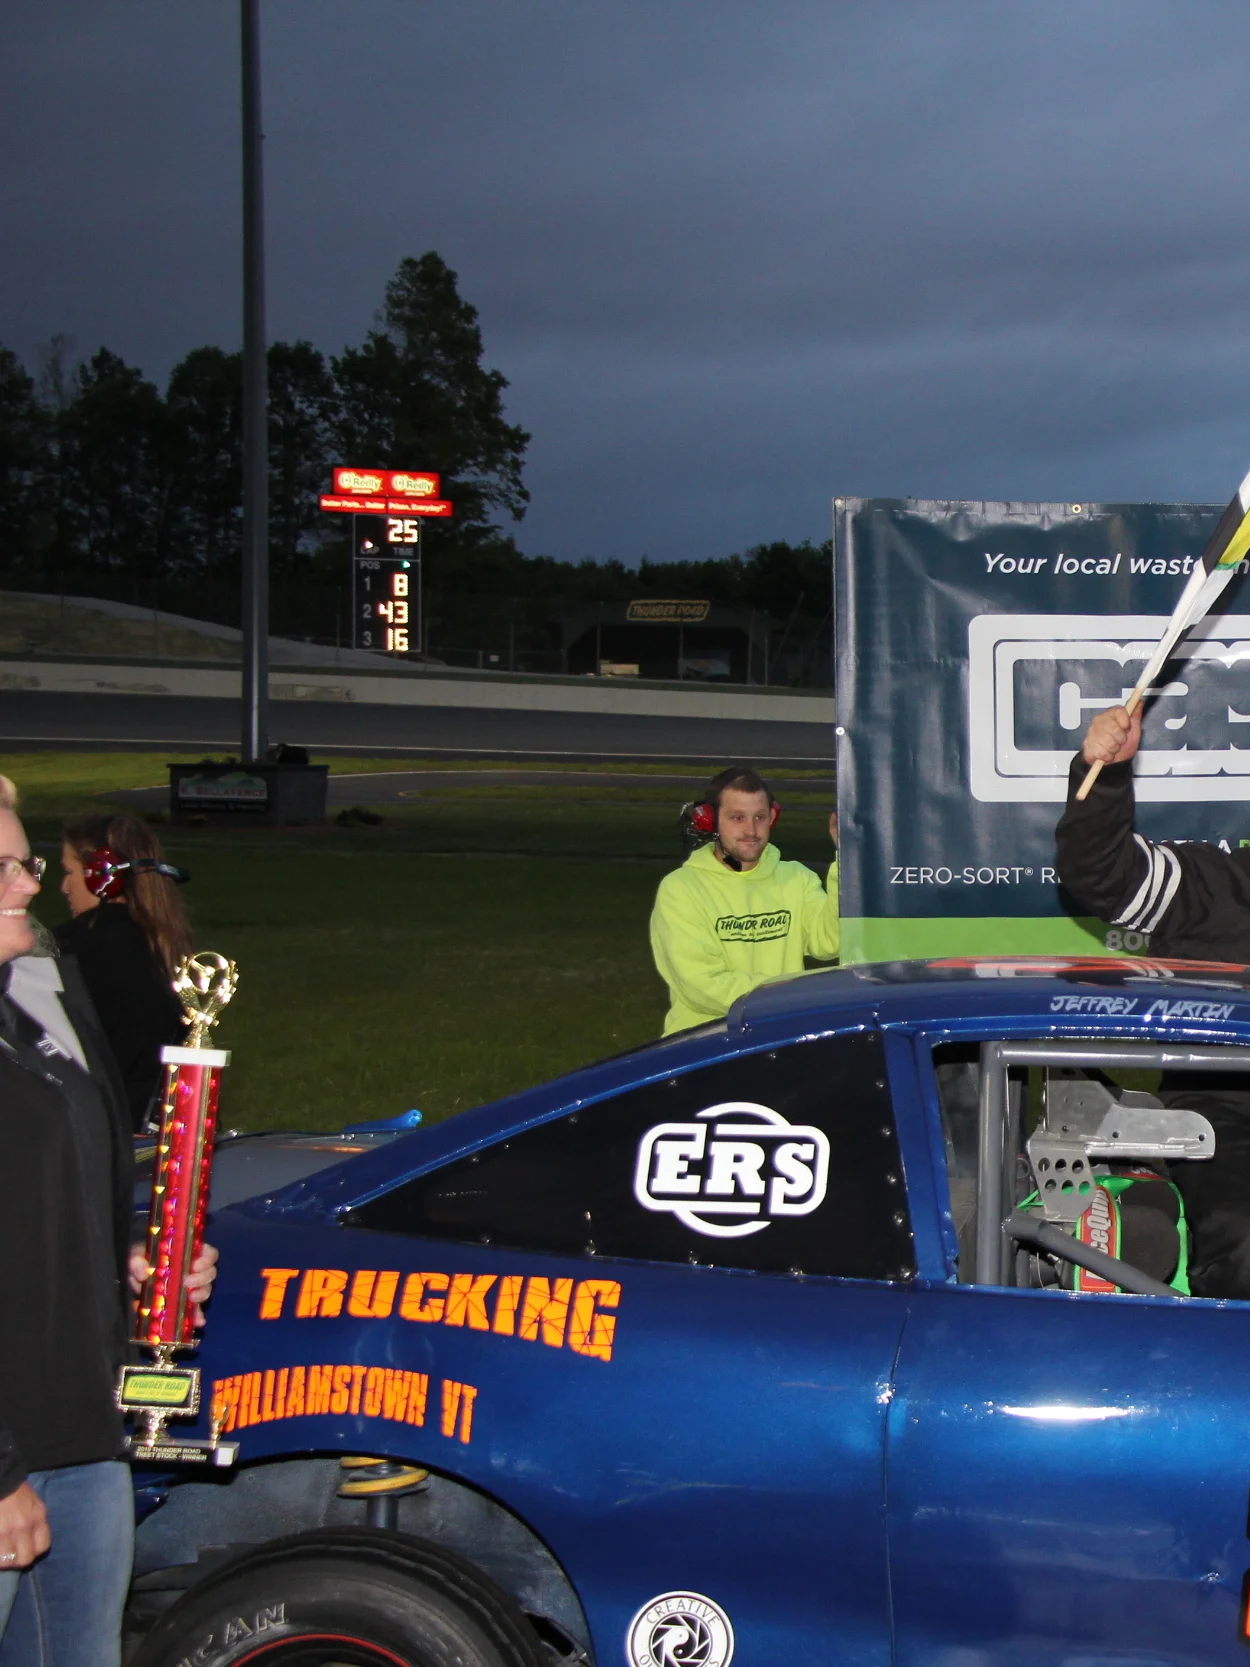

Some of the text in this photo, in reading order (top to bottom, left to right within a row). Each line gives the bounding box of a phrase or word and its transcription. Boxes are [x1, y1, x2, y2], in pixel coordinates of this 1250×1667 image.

[387, 518, 419, 543] 25
[393, 547, 414, 555] TIME
[360, 560, 381, 570] POS
[984, 552, 1047, 574] Your
[1053, 553, 1122, 575] local
[1130, 554, 1202, 575] wast
[364, 572, 409, 597] 1 8
[362, 600, 409, 624] 2 43
[363, 628, 409, 652] 3 16
[1049, 996, 1235, 1019] JEFFREY MARTIN
[650, 1140, 817, 1198] ERS
[258, 1267, 622, 1363] TRUCKING
[211, 1364, 478, 1445] WILLIAMSTOWN VT
[646, 1598, 720, 1627] CREATIVE
